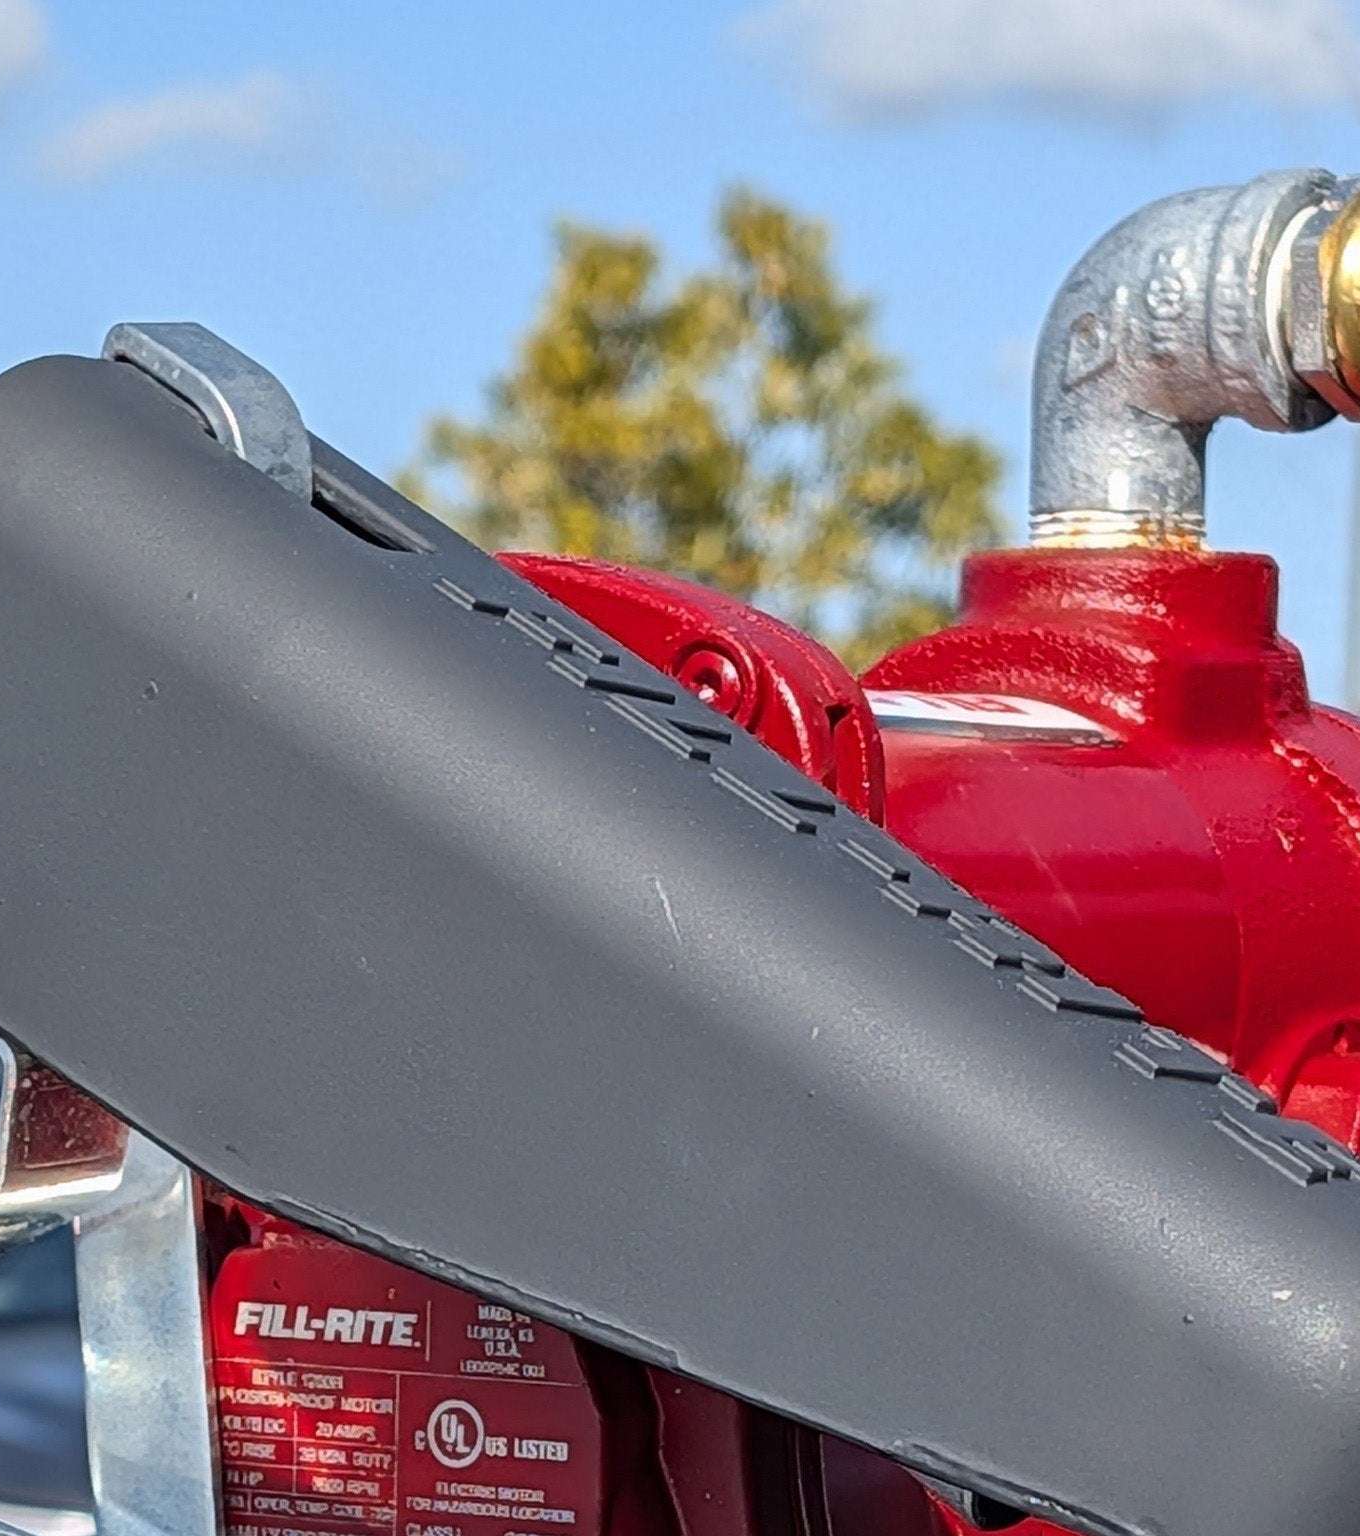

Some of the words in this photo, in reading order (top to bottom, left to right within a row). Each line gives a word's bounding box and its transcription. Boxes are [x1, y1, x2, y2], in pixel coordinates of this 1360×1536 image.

[234, 1301, 419, 1347] FILL-RITE
[341, 1396, 393, 1414] MOTOR
[334, 1424, 376, 1442] AMPS
[514, 1437, 569, 1462] LISTED
